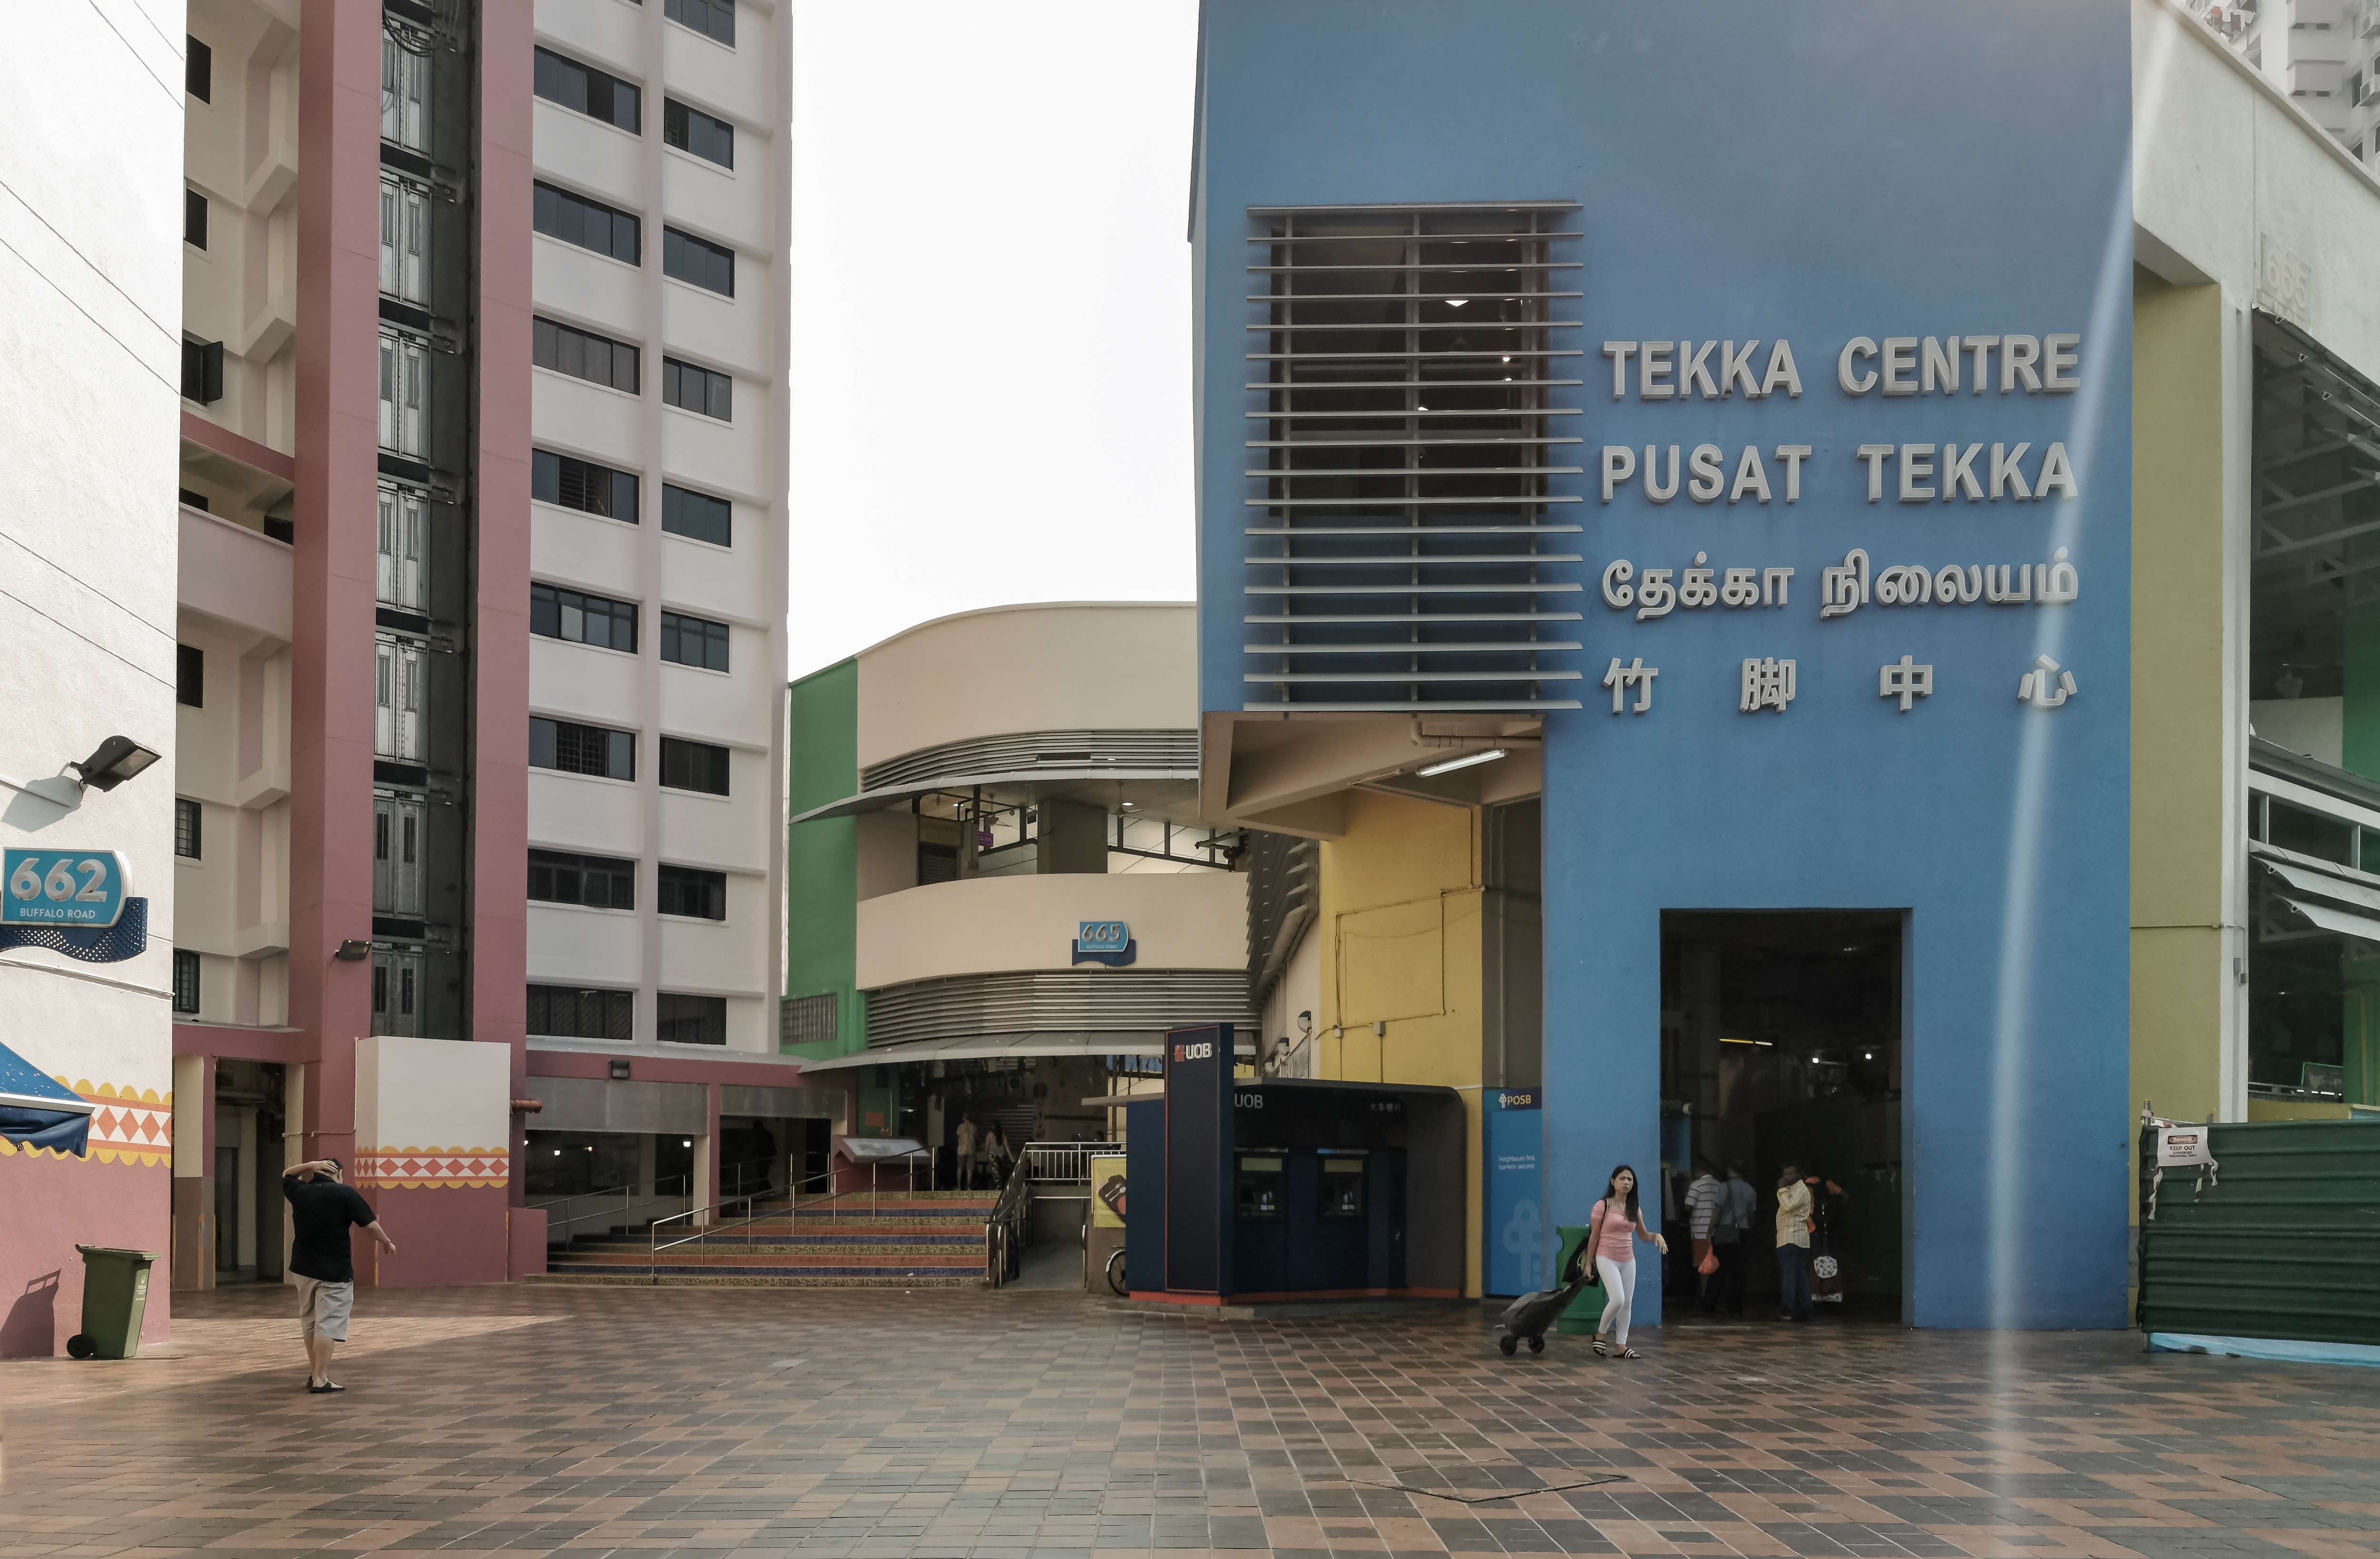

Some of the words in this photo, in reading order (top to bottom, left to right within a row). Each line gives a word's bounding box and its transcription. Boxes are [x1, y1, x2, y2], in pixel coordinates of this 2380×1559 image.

[1603, 339, 1803, 399] TEKKA
[1837, 333, 2080, 397] CENTRE
[1601, 444, 1812, 503] PUSAT
[1857, 442, 2079, 503] TEKKA
[1603, 551, 1795, 621] தேக்கா
[1820, 546, 2079, 620] நிலையம்
[10, 857, 108, 902] 662
[20, 908, 64, 918] BUFFALO
[68, 909, 96, 919] ROAD
[1081, 924, 1121, 943] 665
[1186, 1043, 1212, 1059] UOB
[1234, 1093, 1263, 1109] UOB
[1507, 1094, 1531, 1105] POSB
